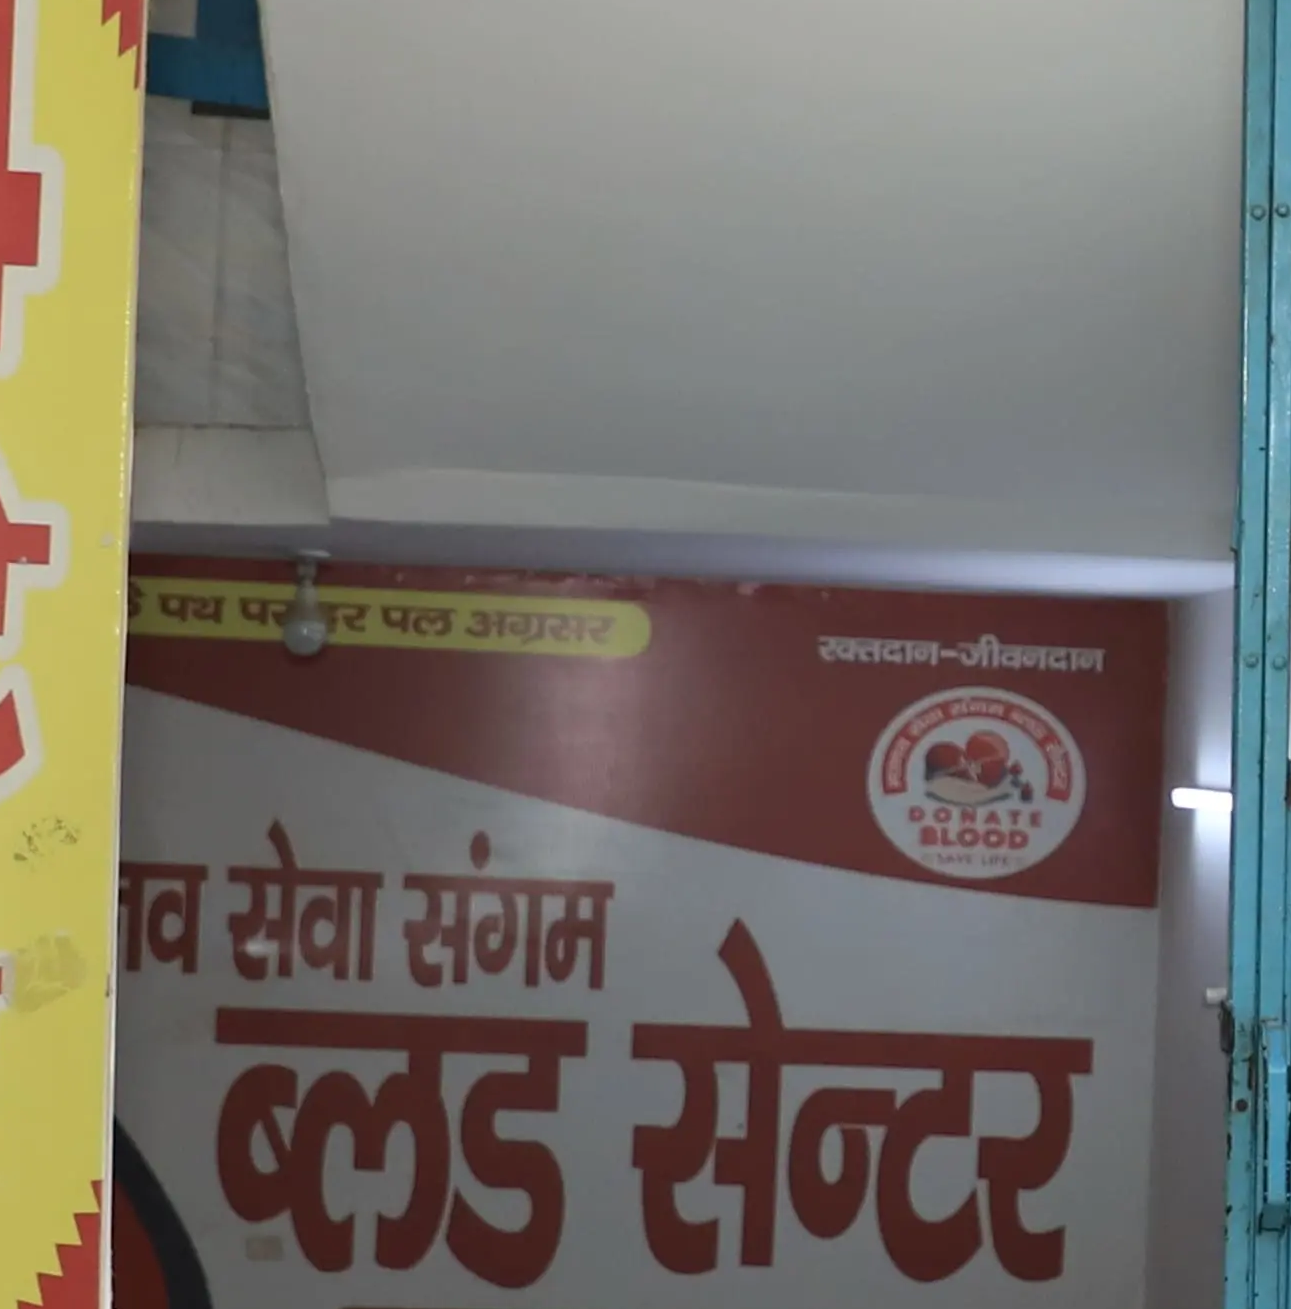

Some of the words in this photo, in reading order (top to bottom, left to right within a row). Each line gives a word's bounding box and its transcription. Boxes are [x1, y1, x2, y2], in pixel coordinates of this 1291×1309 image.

[381, 604, 457, 636] पल
[908, 806, 1042, 828] DONATE
[919, 825, 1029, 849] BLOOD
[228, 818, 382, 982] सेवा
[403, 831, 614, 990] संगम
[215, 1006, 588, 1290] ब्लड
[631, 918, 1093, 1283] सेन्टर
